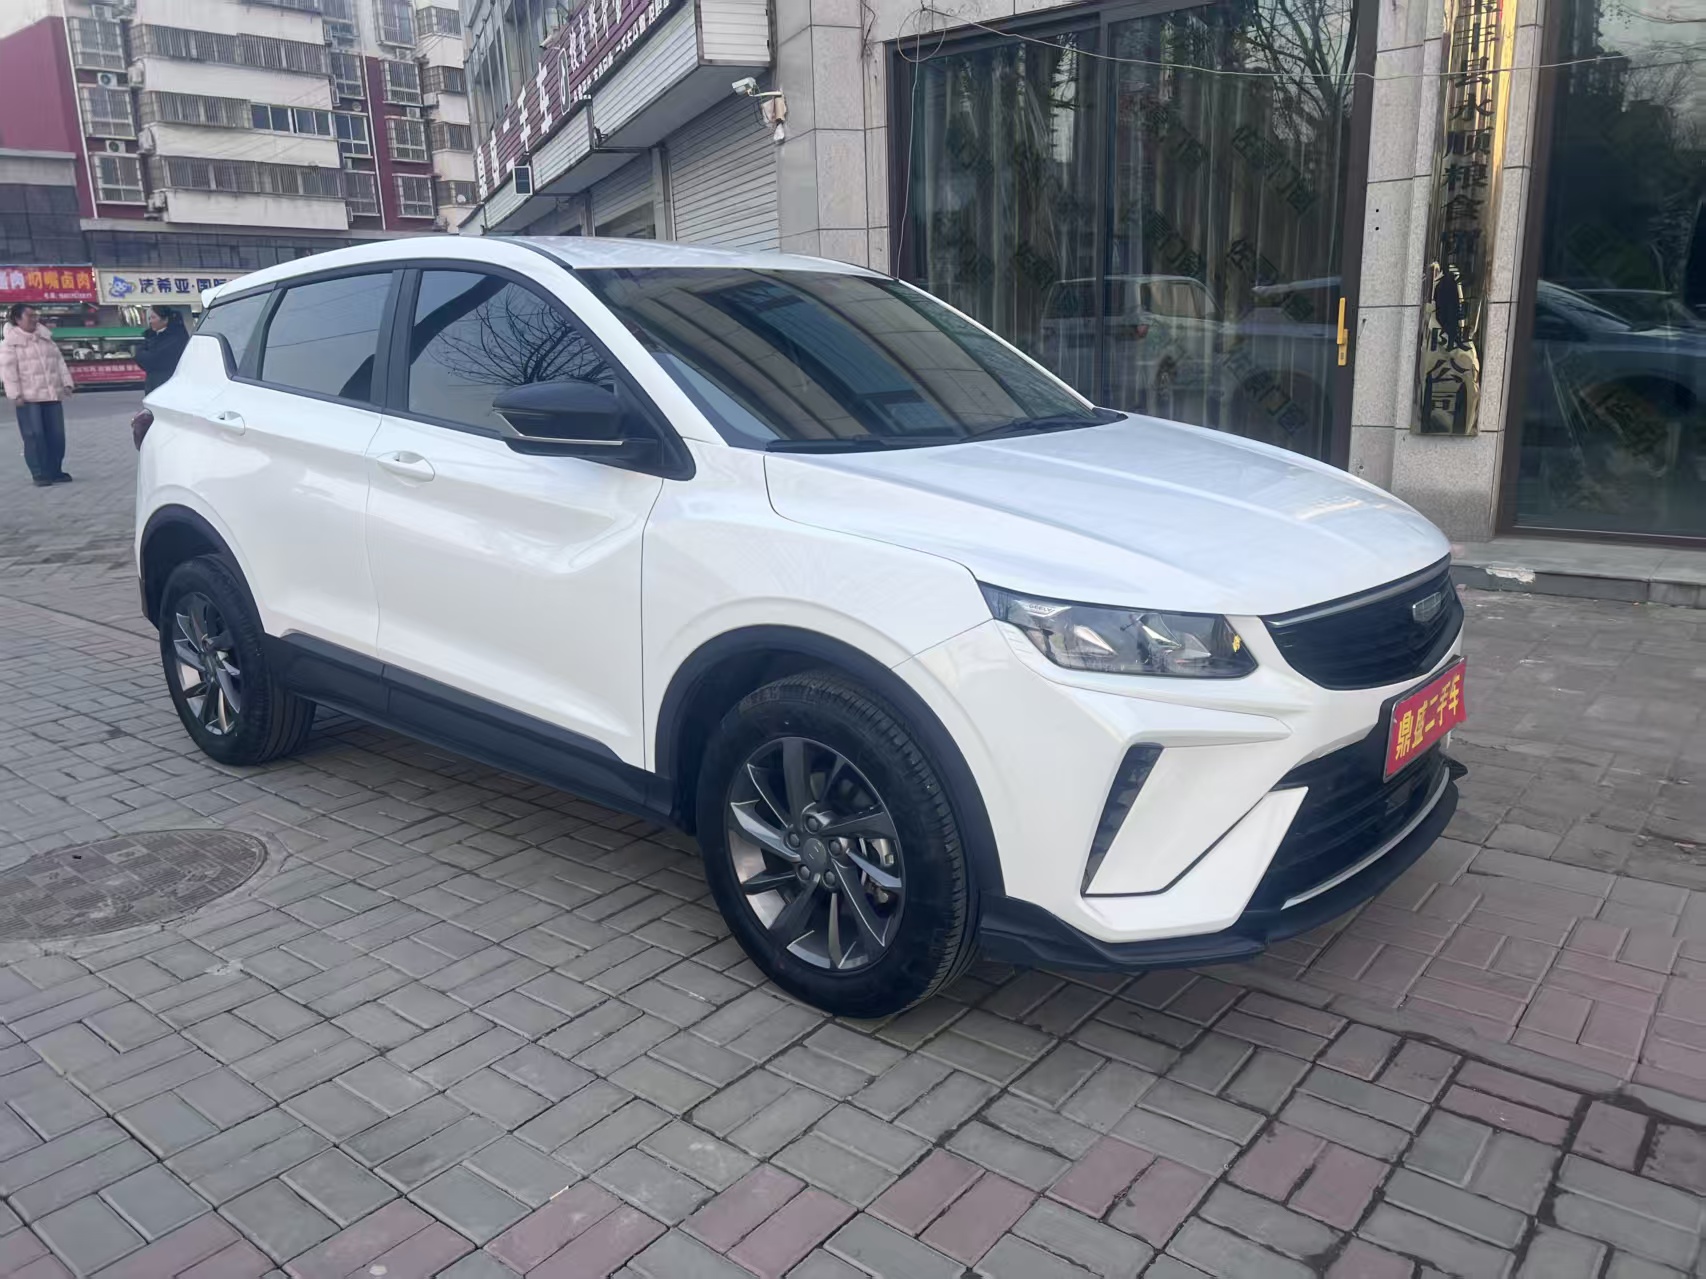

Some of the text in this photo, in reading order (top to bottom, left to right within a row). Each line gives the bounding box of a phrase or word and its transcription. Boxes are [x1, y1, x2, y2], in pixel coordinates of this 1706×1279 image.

[1395, 674, 1460, 760] 鼎盛二手车
